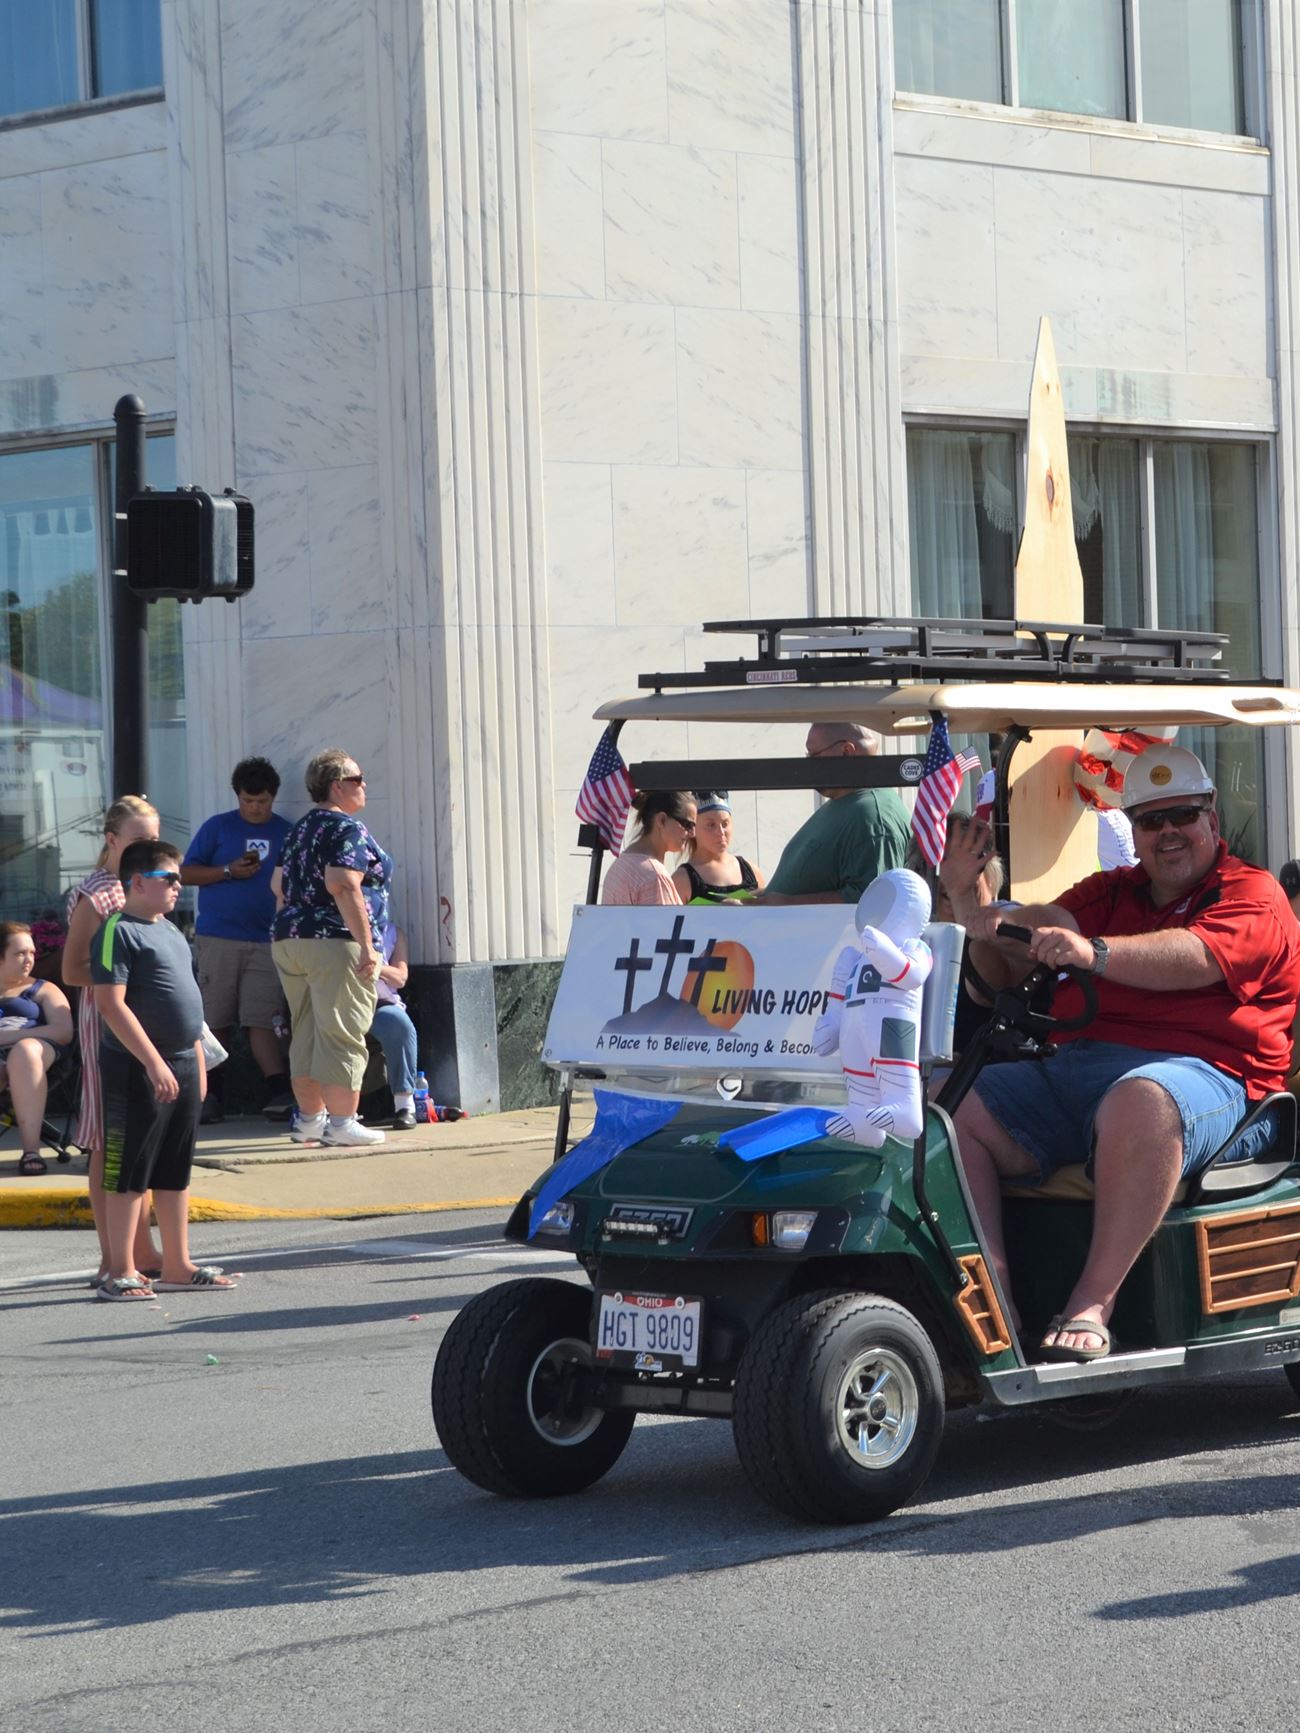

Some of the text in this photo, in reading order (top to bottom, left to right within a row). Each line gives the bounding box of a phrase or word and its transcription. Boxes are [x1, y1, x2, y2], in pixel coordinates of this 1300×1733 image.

[711, 989, 777, 1015] LIVING
[595, 1035, 605, 1049] A
[608, 1034, 641, 1050] Place
[646, 1035, 659, 1051] to
[663, 1036, 712, 1055] Believe,
[716, 1037, 759, 1058] Belong
[763, 1039, 774, 1053] &
[636, 1296, 664, 1308] OHIO
[602, 1309, 694, 1352] HGT 9809
